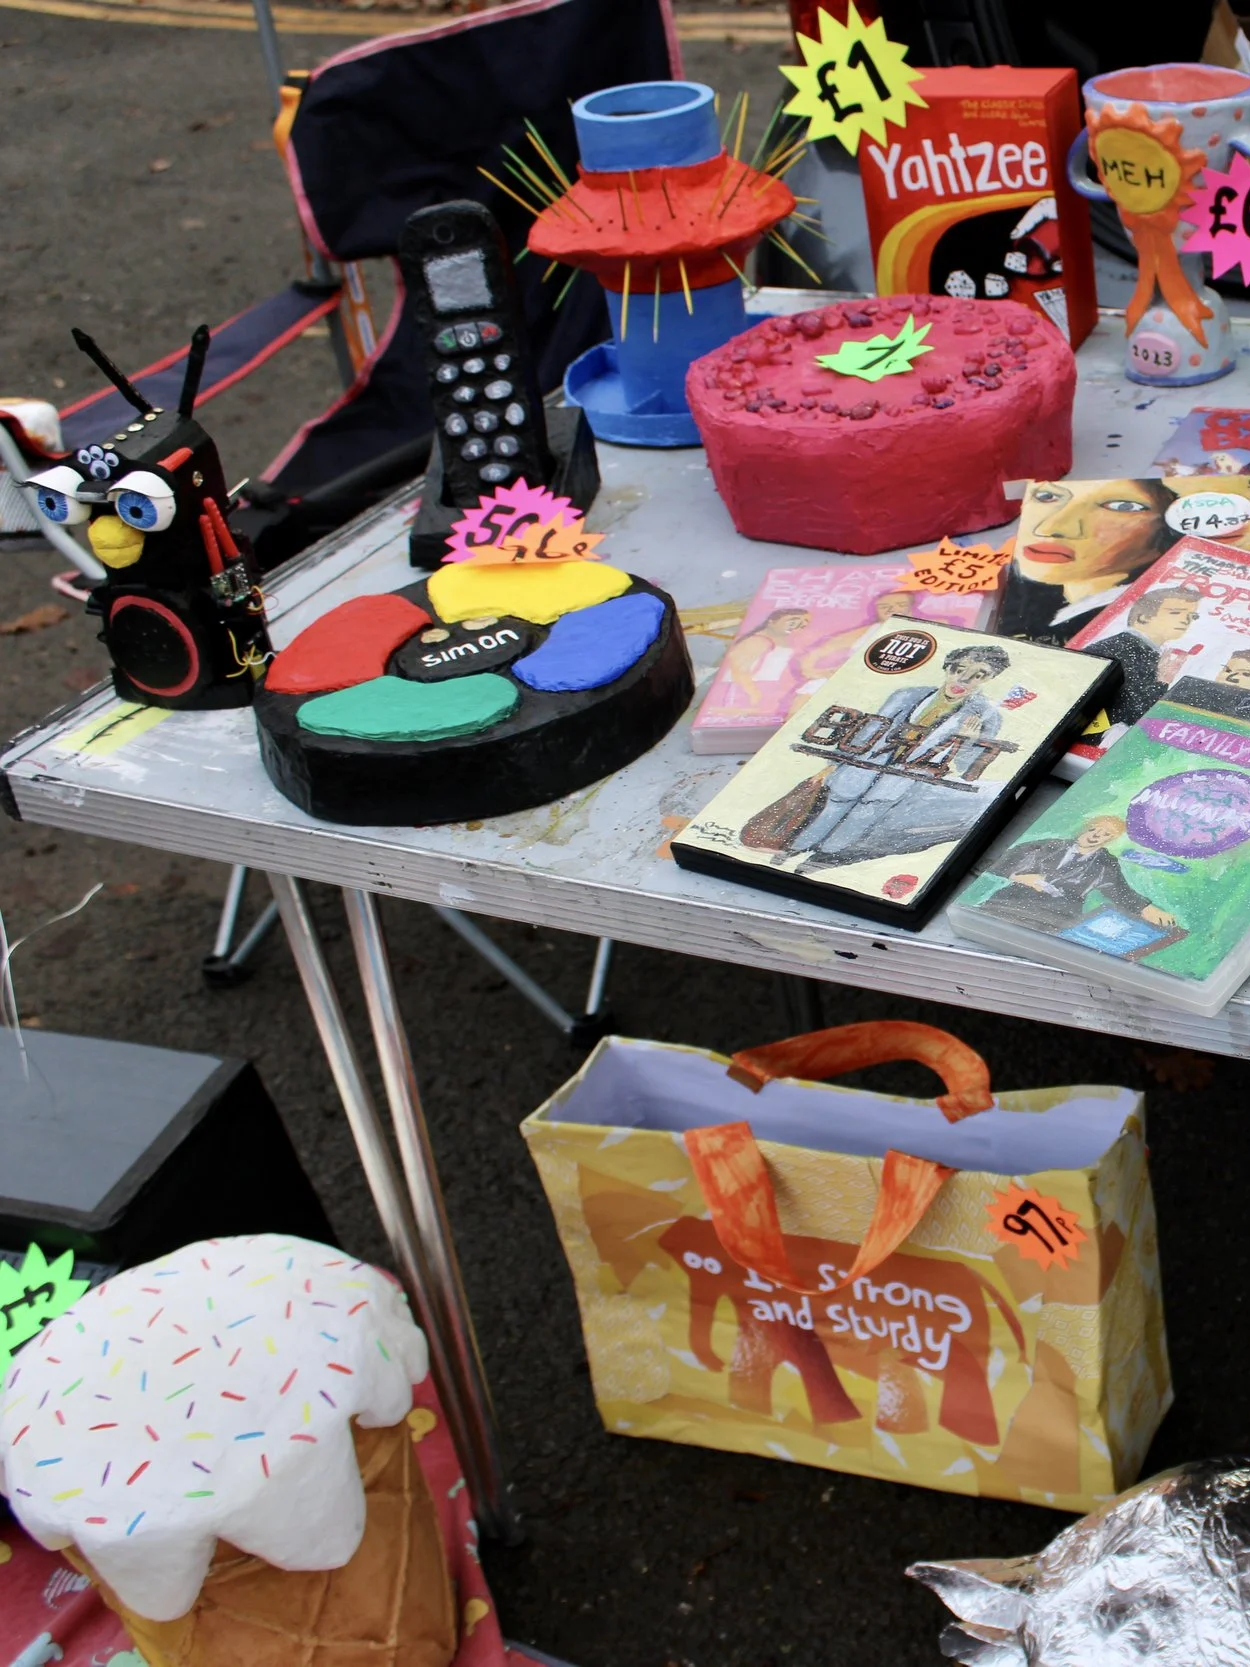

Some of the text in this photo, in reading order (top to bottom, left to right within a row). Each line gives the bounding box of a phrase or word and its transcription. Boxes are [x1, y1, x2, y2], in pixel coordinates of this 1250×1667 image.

[816, 40, 893, 122] £1
[867, 133, 1048, 198] Yahtzee
[1102, 160, 1165, 189] MEH
[1132, 345, 1173, 367] 2013
[914, 568, 994, 592] EDITION
[939, 558, 985, 579] £5
[747, 1296, 814, 1331] and
